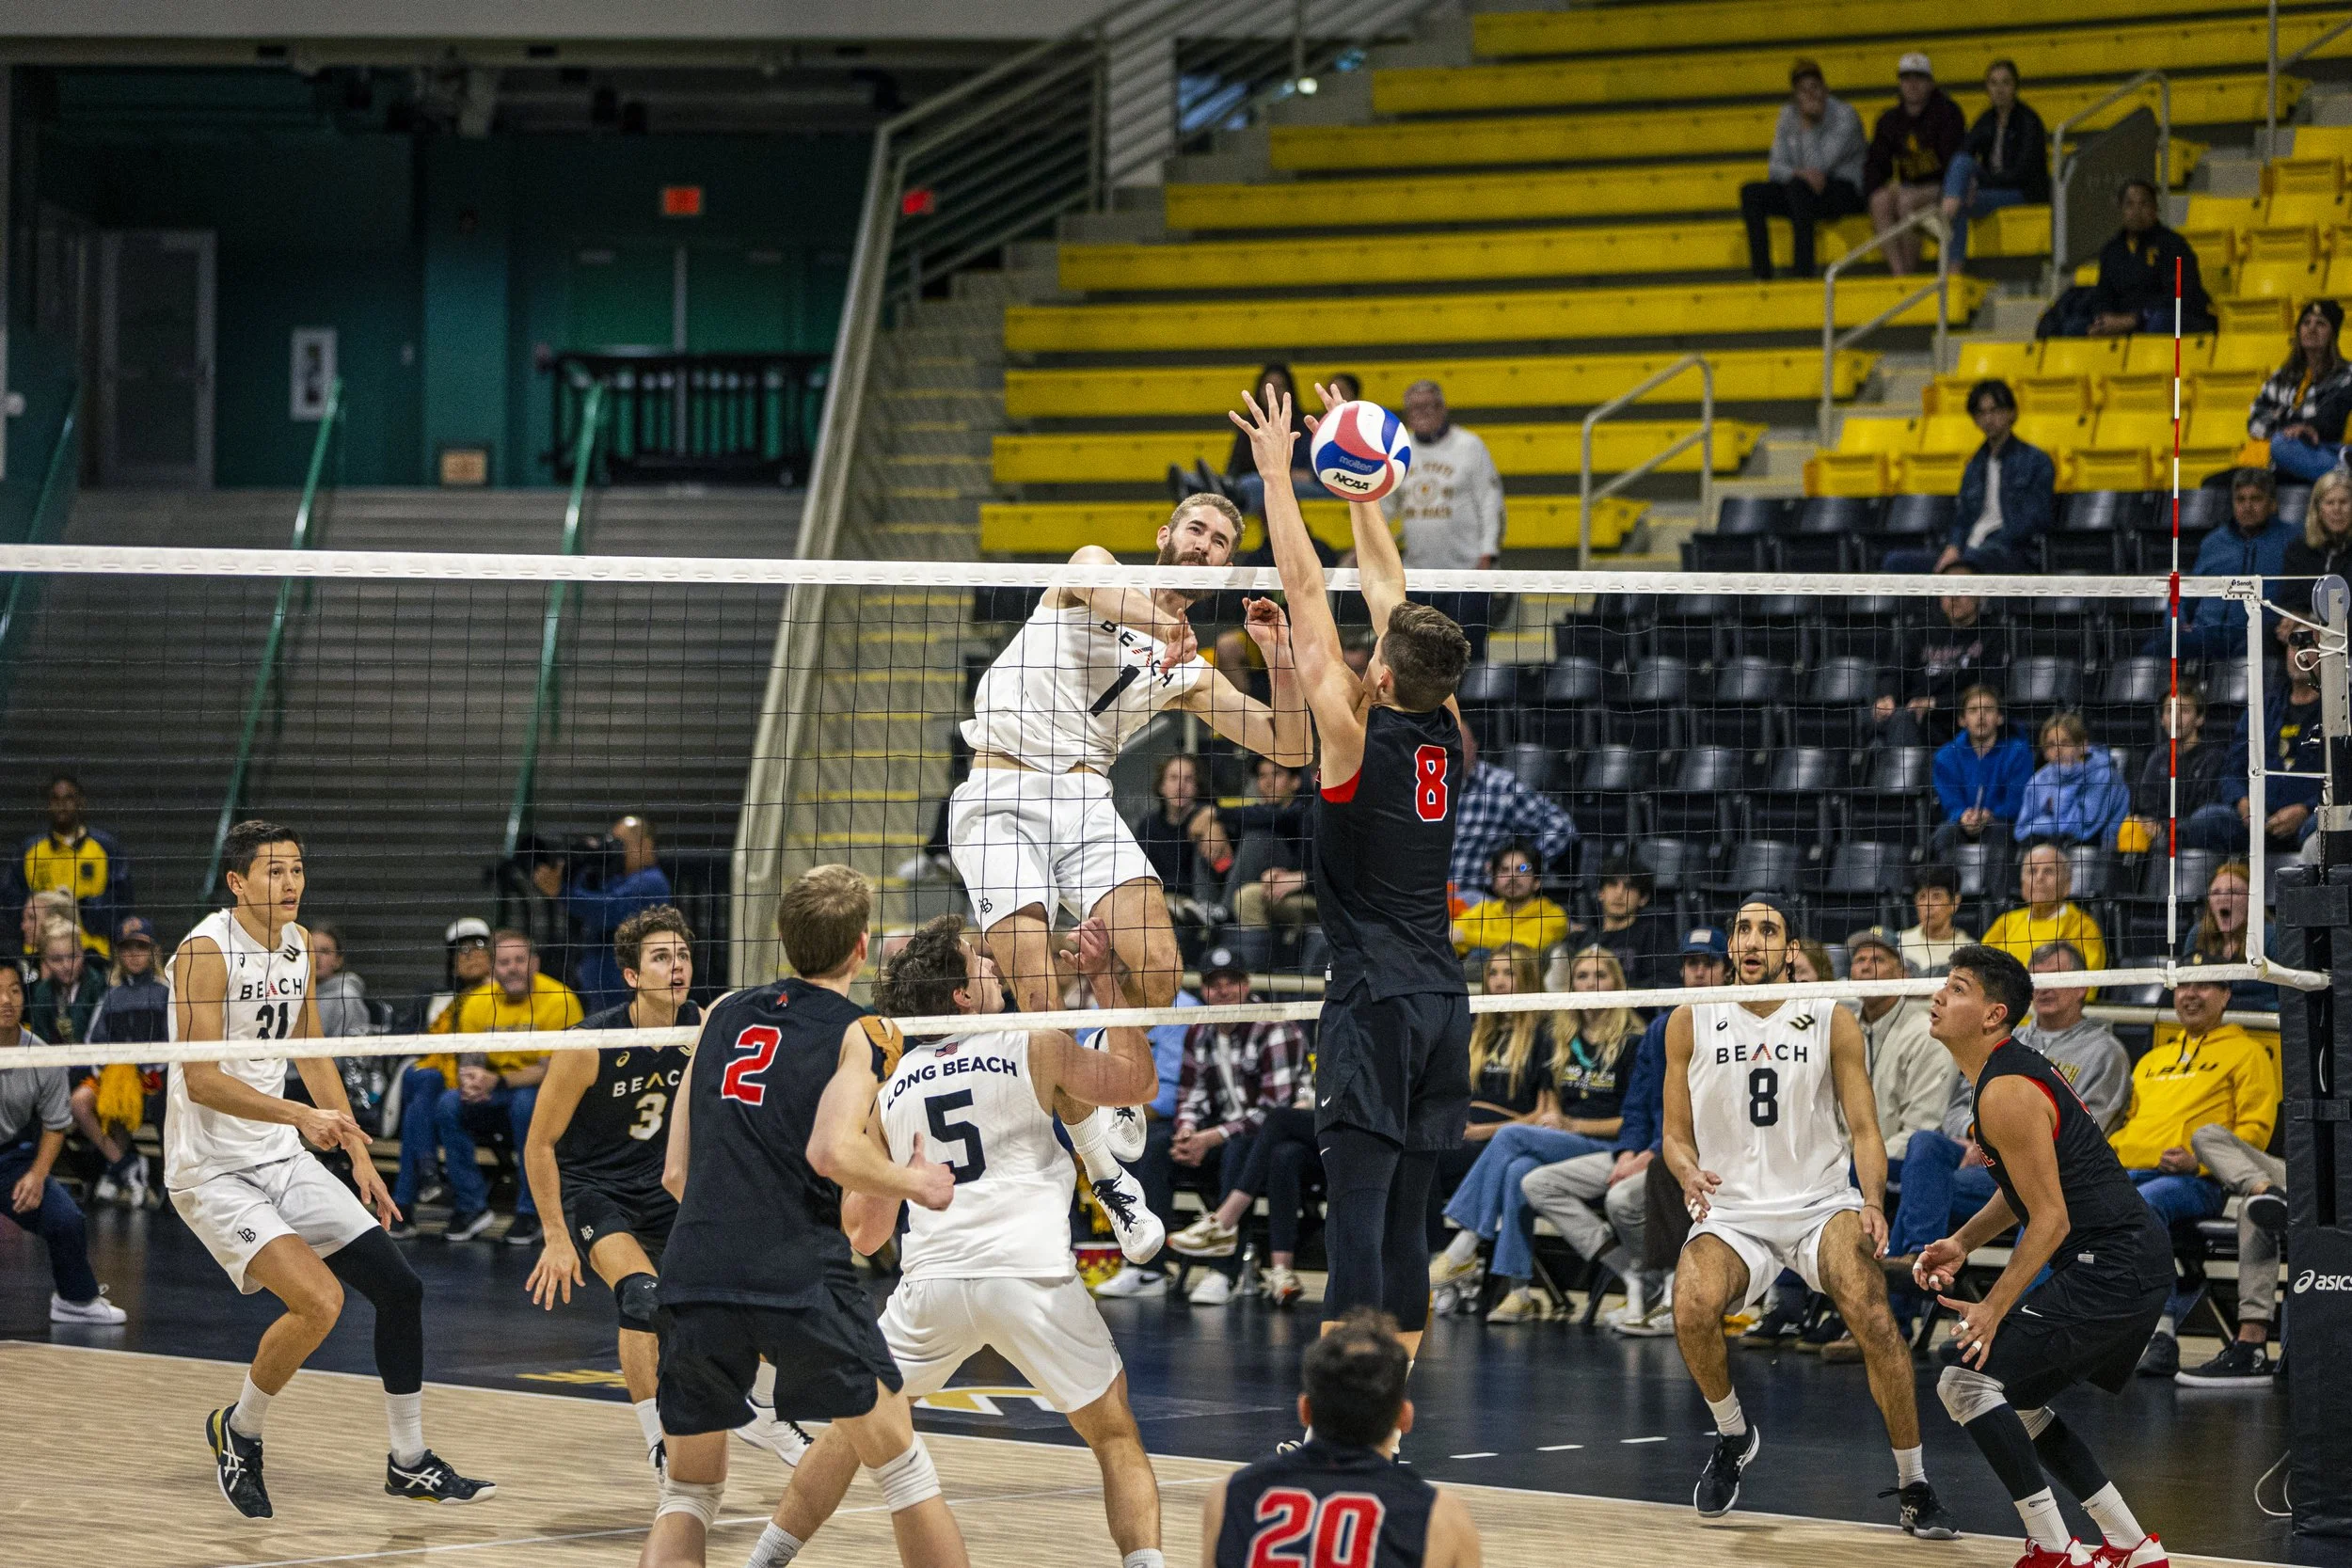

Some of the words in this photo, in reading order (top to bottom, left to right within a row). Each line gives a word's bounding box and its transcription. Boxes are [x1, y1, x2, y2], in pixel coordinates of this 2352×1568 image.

[1333, 472, 1370, 490] NCAA
[1339, 455, 1374, 472] molten
[1414, 743, 1448, 821] 8
[239, 978, 302, 1001] BEACH
[721, 1022, 783, 1106] 2
[1715, 1043, 1808, 1065] BEACH
[612, 1069, 680, 1098] BEAC
[887, 1065, 937, 1111] LONG
[943, 1055, 1018, 1078] BEACH
[1749, 1068, 1779, 1127] 8
[628, 1092, 668, 1140] 3
[924, 1088, 986, 1185] 5
[1244, 1485, 1387, 1568] 20
